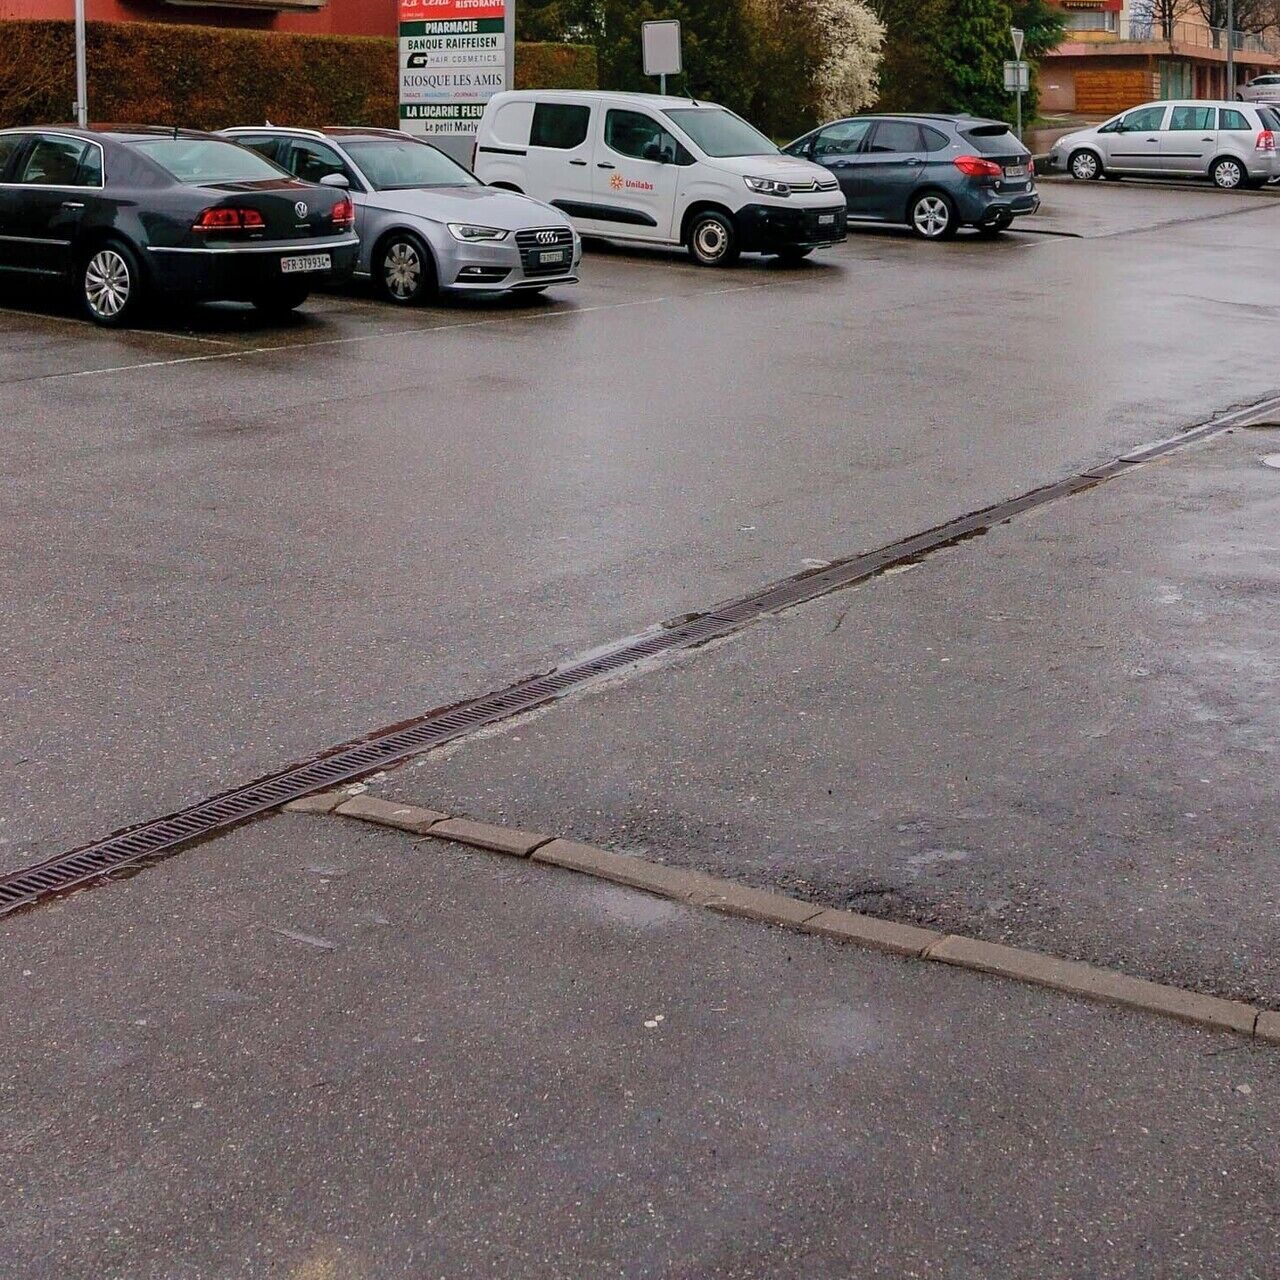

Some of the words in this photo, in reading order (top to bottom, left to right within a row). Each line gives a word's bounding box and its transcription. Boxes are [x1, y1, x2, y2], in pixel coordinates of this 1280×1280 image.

[425, 20, 478, 34] PHARMACIE
[408, 38, 444, 50] BANQUE
[446, 36, 497, 49] RAIFFEISEN
[430, 56, 448, 64] HAIR
[452, 54, 497, 63] COSMETICS
[403, 74, 451, 88] KIOSQUE
[453, 74, 471, 86] LES
[473, 73, 502, 86] AMIS
[406, 106, 418, 118] LA
[420, 105, 459, 118] LUCARNE
[461, 104, 484, 117] FLEU
[425, 122, 433, 131] Le
[435, 121, 453, 133] petit
[454, 121, 479, 133] Marly
[625, 180, 654, 190] Unilabs
